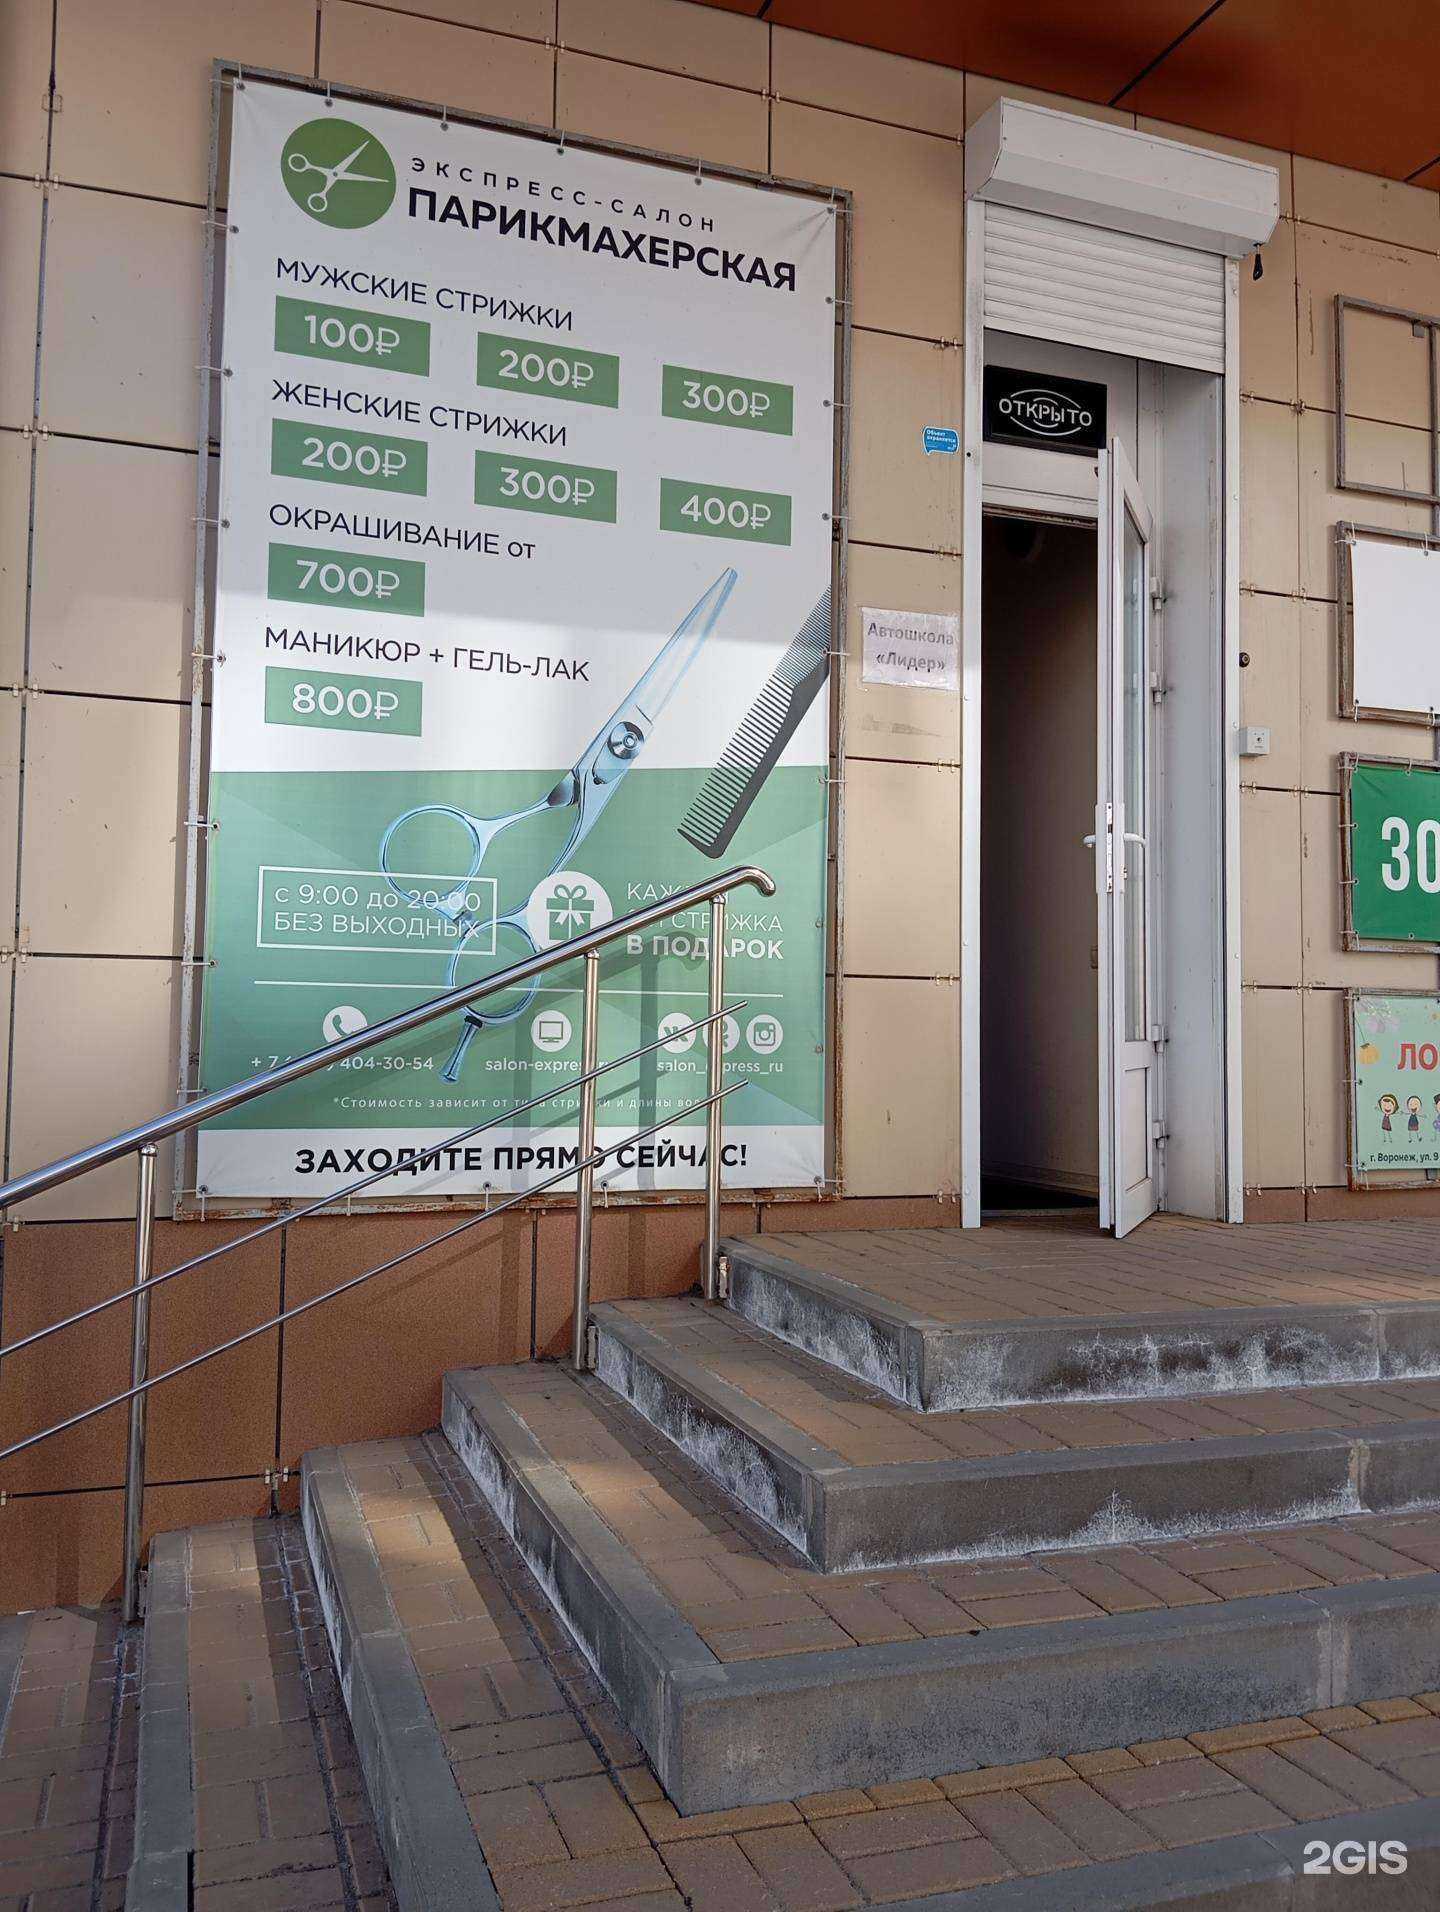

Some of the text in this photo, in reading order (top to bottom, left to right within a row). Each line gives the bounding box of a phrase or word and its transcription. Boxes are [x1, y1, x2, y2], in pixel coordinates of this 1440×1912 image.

[412, 157, 715, 232] ЭКСПРЕСС-САЛОН
[408, 187, 797, 291] ПАРИКМАХЕРСКАЯ
[276, 258, 573, 331] МУЖСКИЕ СТРИЖКИ
[272, 380, 567, 447] ЖЕНСКИЕ СТРИЖКИ
[999, 398, 1092, 427] ОТКРЫТО
[269, 504, 536, 559] ОКРАШИВАНИЕ от
[868, 621, 954, 645] Автошкола
[265, 627, 590, 682] МАНИКЮР + ГЕЛЬ-ЛАК
[876, 651, 945, 673] «Лидер»
[299, 884, 359, 906] 9:00
[367, 892, 399, 910] до
[408, 889, 481, 912] 20:00
[274, 912, 480, 939] БЕЗ ВЫХОДНЫХ
[626, 934, 785, 960] В ПОДРОК
[340, 1056, 434, 1071] 404-30-54
[429, 1097, 487, 1109] зависит
[492, 1098, 509, 1109] от
[295, 1147, 482, 1176] ЗАХОДИТЕ
[1377, 1152, 1419, 1164] Воронеж,
